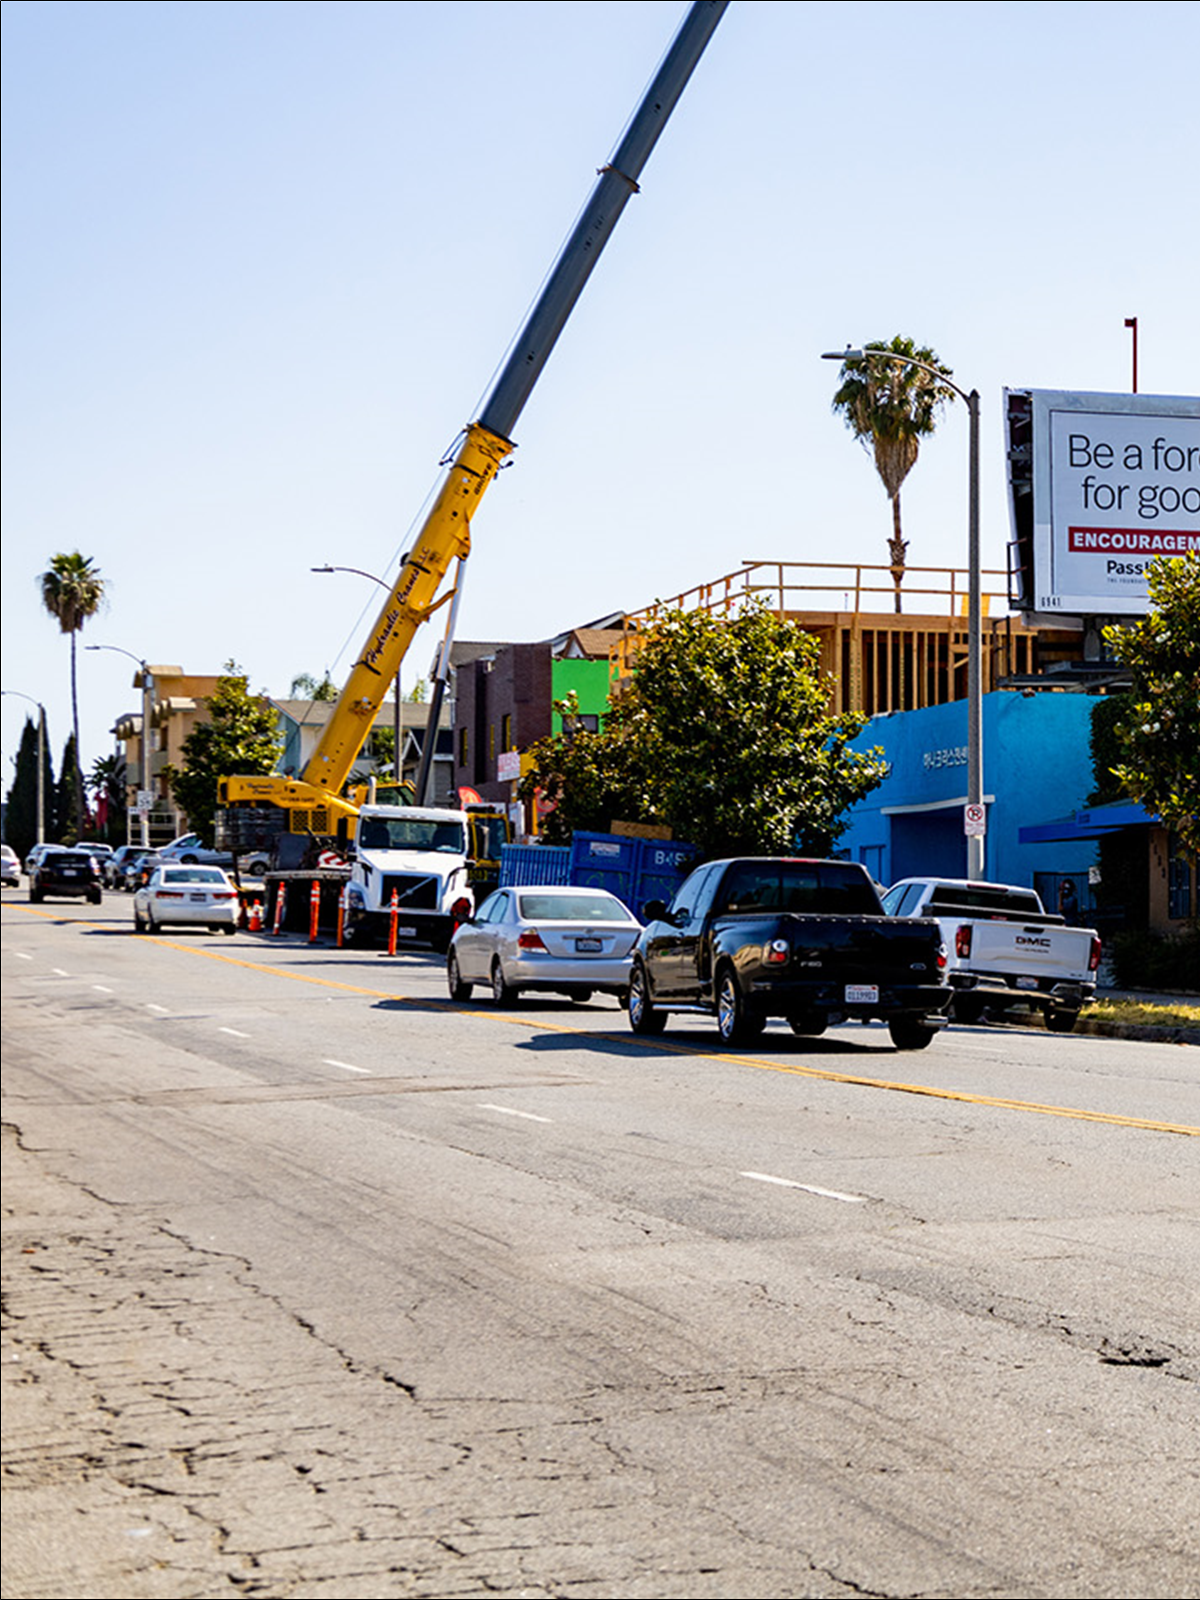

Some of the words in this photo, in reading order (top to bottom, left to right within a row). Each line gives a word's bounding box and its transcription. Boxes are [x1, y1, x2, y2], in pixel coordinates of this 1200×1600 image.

[1067, 433, 1114, 469] Be
[1123, 444, 1143, 470] a
[1081, 476, 1130, 510] for
[365, 609, 400, 664] Hydraulic
[396, 568, 420, 605] Cranes
[1015, 936, 1051, 948] GMC
